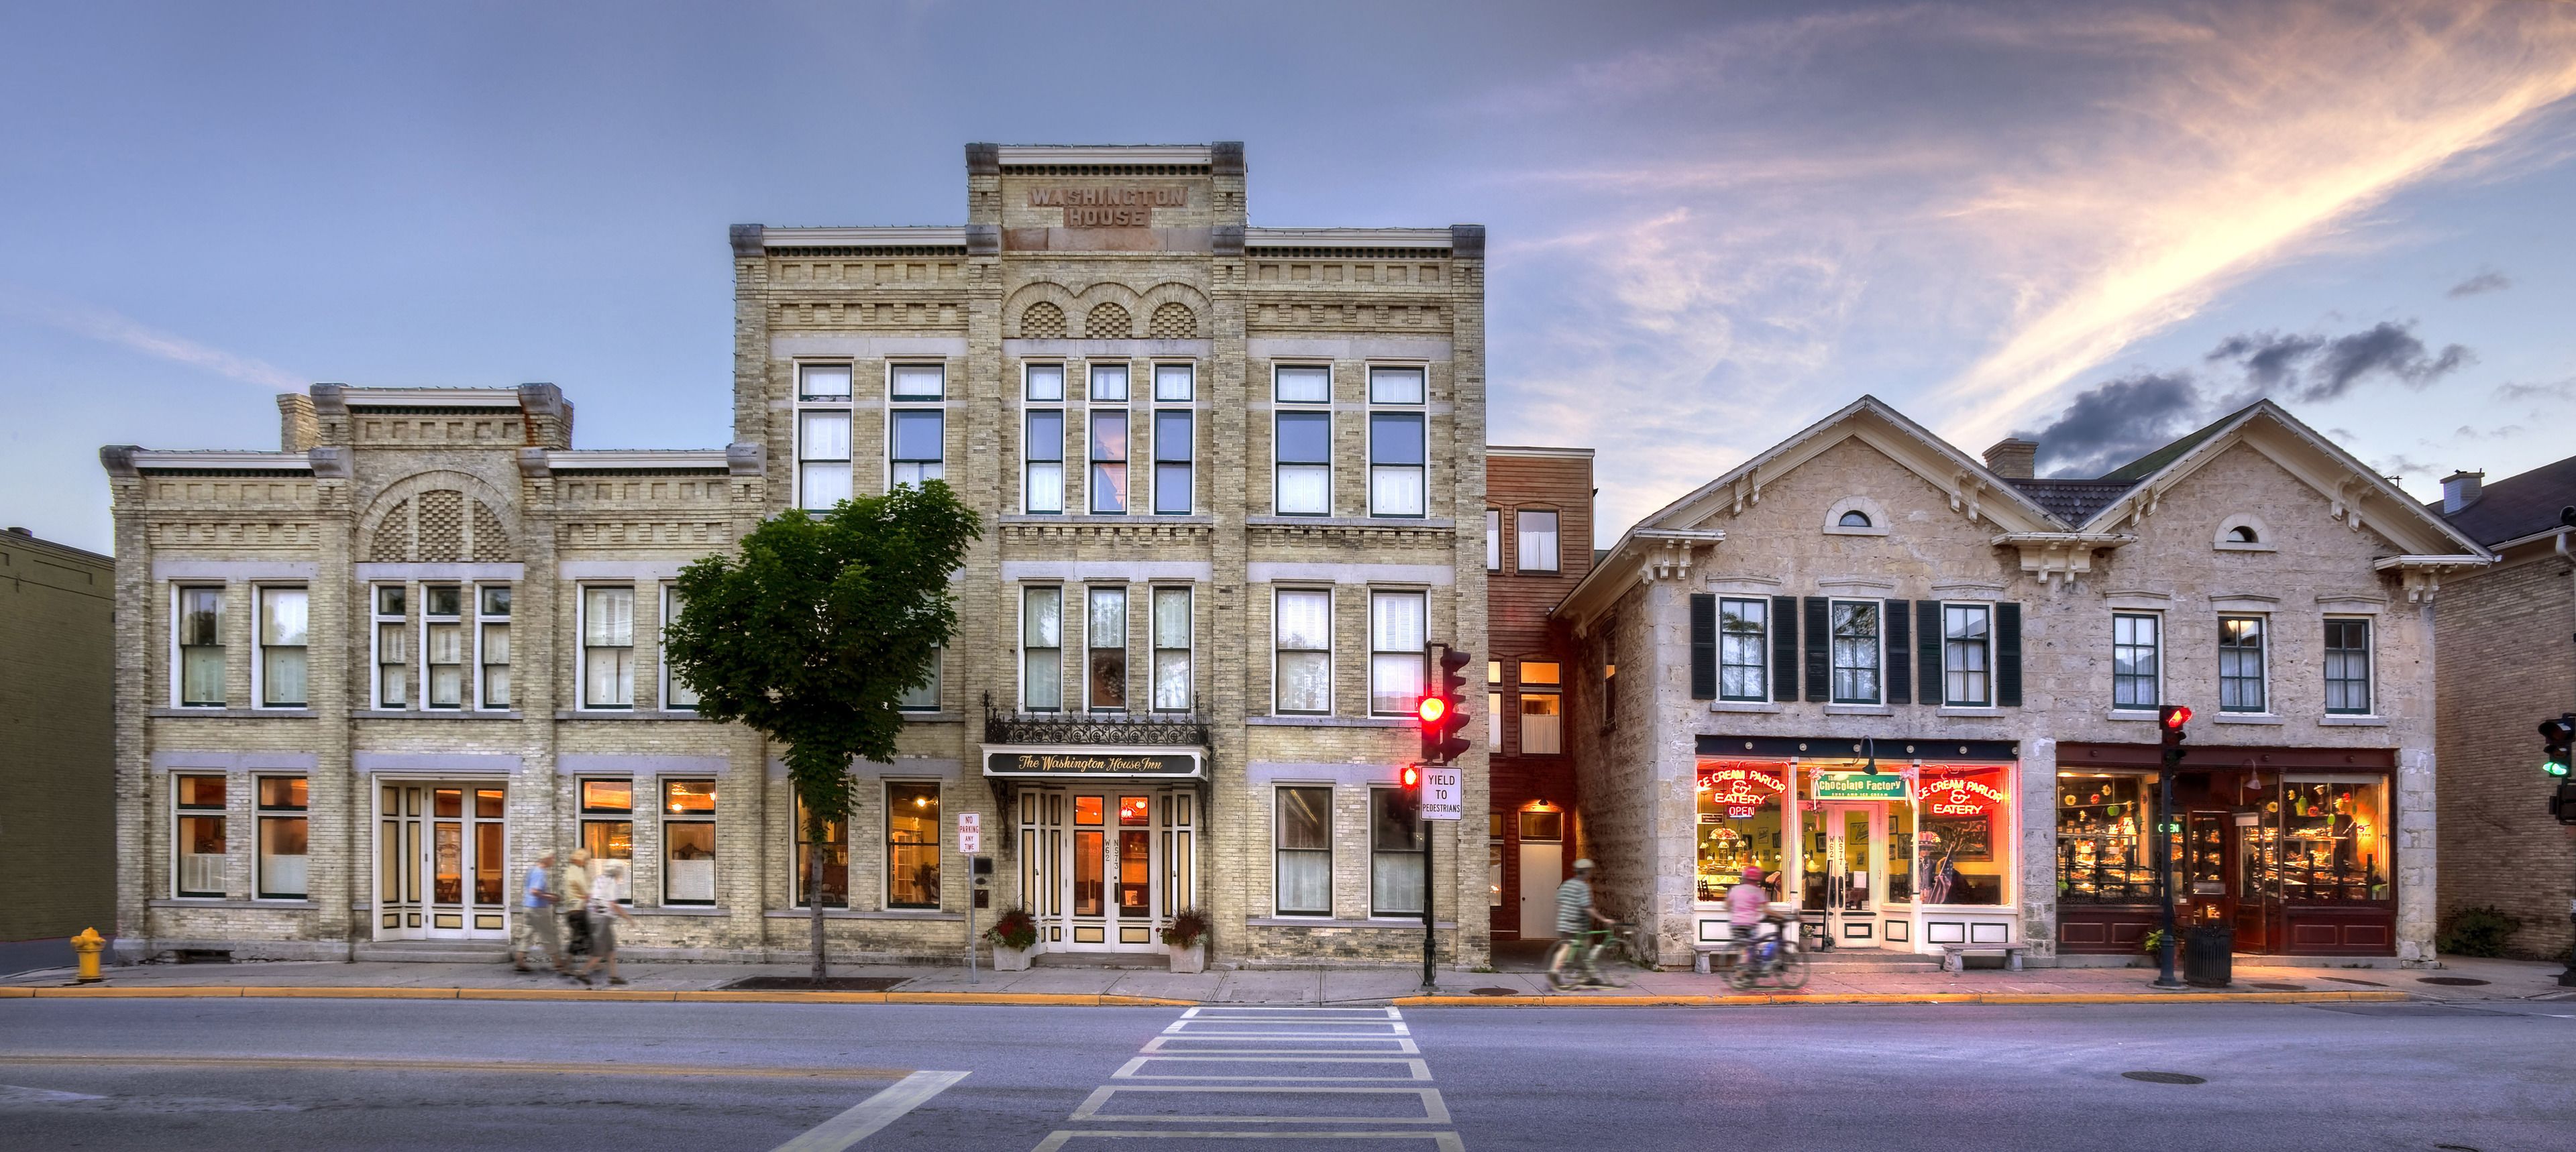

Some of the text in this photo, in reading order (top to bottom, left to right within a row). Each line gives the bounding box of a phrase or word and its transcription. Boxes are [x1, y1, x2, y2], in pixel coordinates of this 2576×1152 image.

[1031, 187, 1187, 206] WASHINGTON
[1069, 209, 1146, 227] HOUSE
[1018, 755, 1163, 772] The Washington House Inn
[1428, 774, 1455, 785] YIELD
[1697, 769, 1786, 794] CE CREAM PARLOR
[1731, 780, 1752, 795] &
[1819, 780, 1901, 791] Chocolate Factory
[1919, 779, 2003, 803] CE CREAM PARLOR
[1436, 789, 1447, 799] TO
[1715, 793, 1766, 805] EATERY
[1950, 789, 1970, 804] &
[1422, 803, 1460, 813] PEDESTRIANS
[1729, 806, 1755, 816] OPEN
[1933, 804, 1983, 814] EATERY
[965, 816, 973, 824] NO
[960, 825, 979, 833] PARKING
[2158, 823, 2180, 833] OEN
